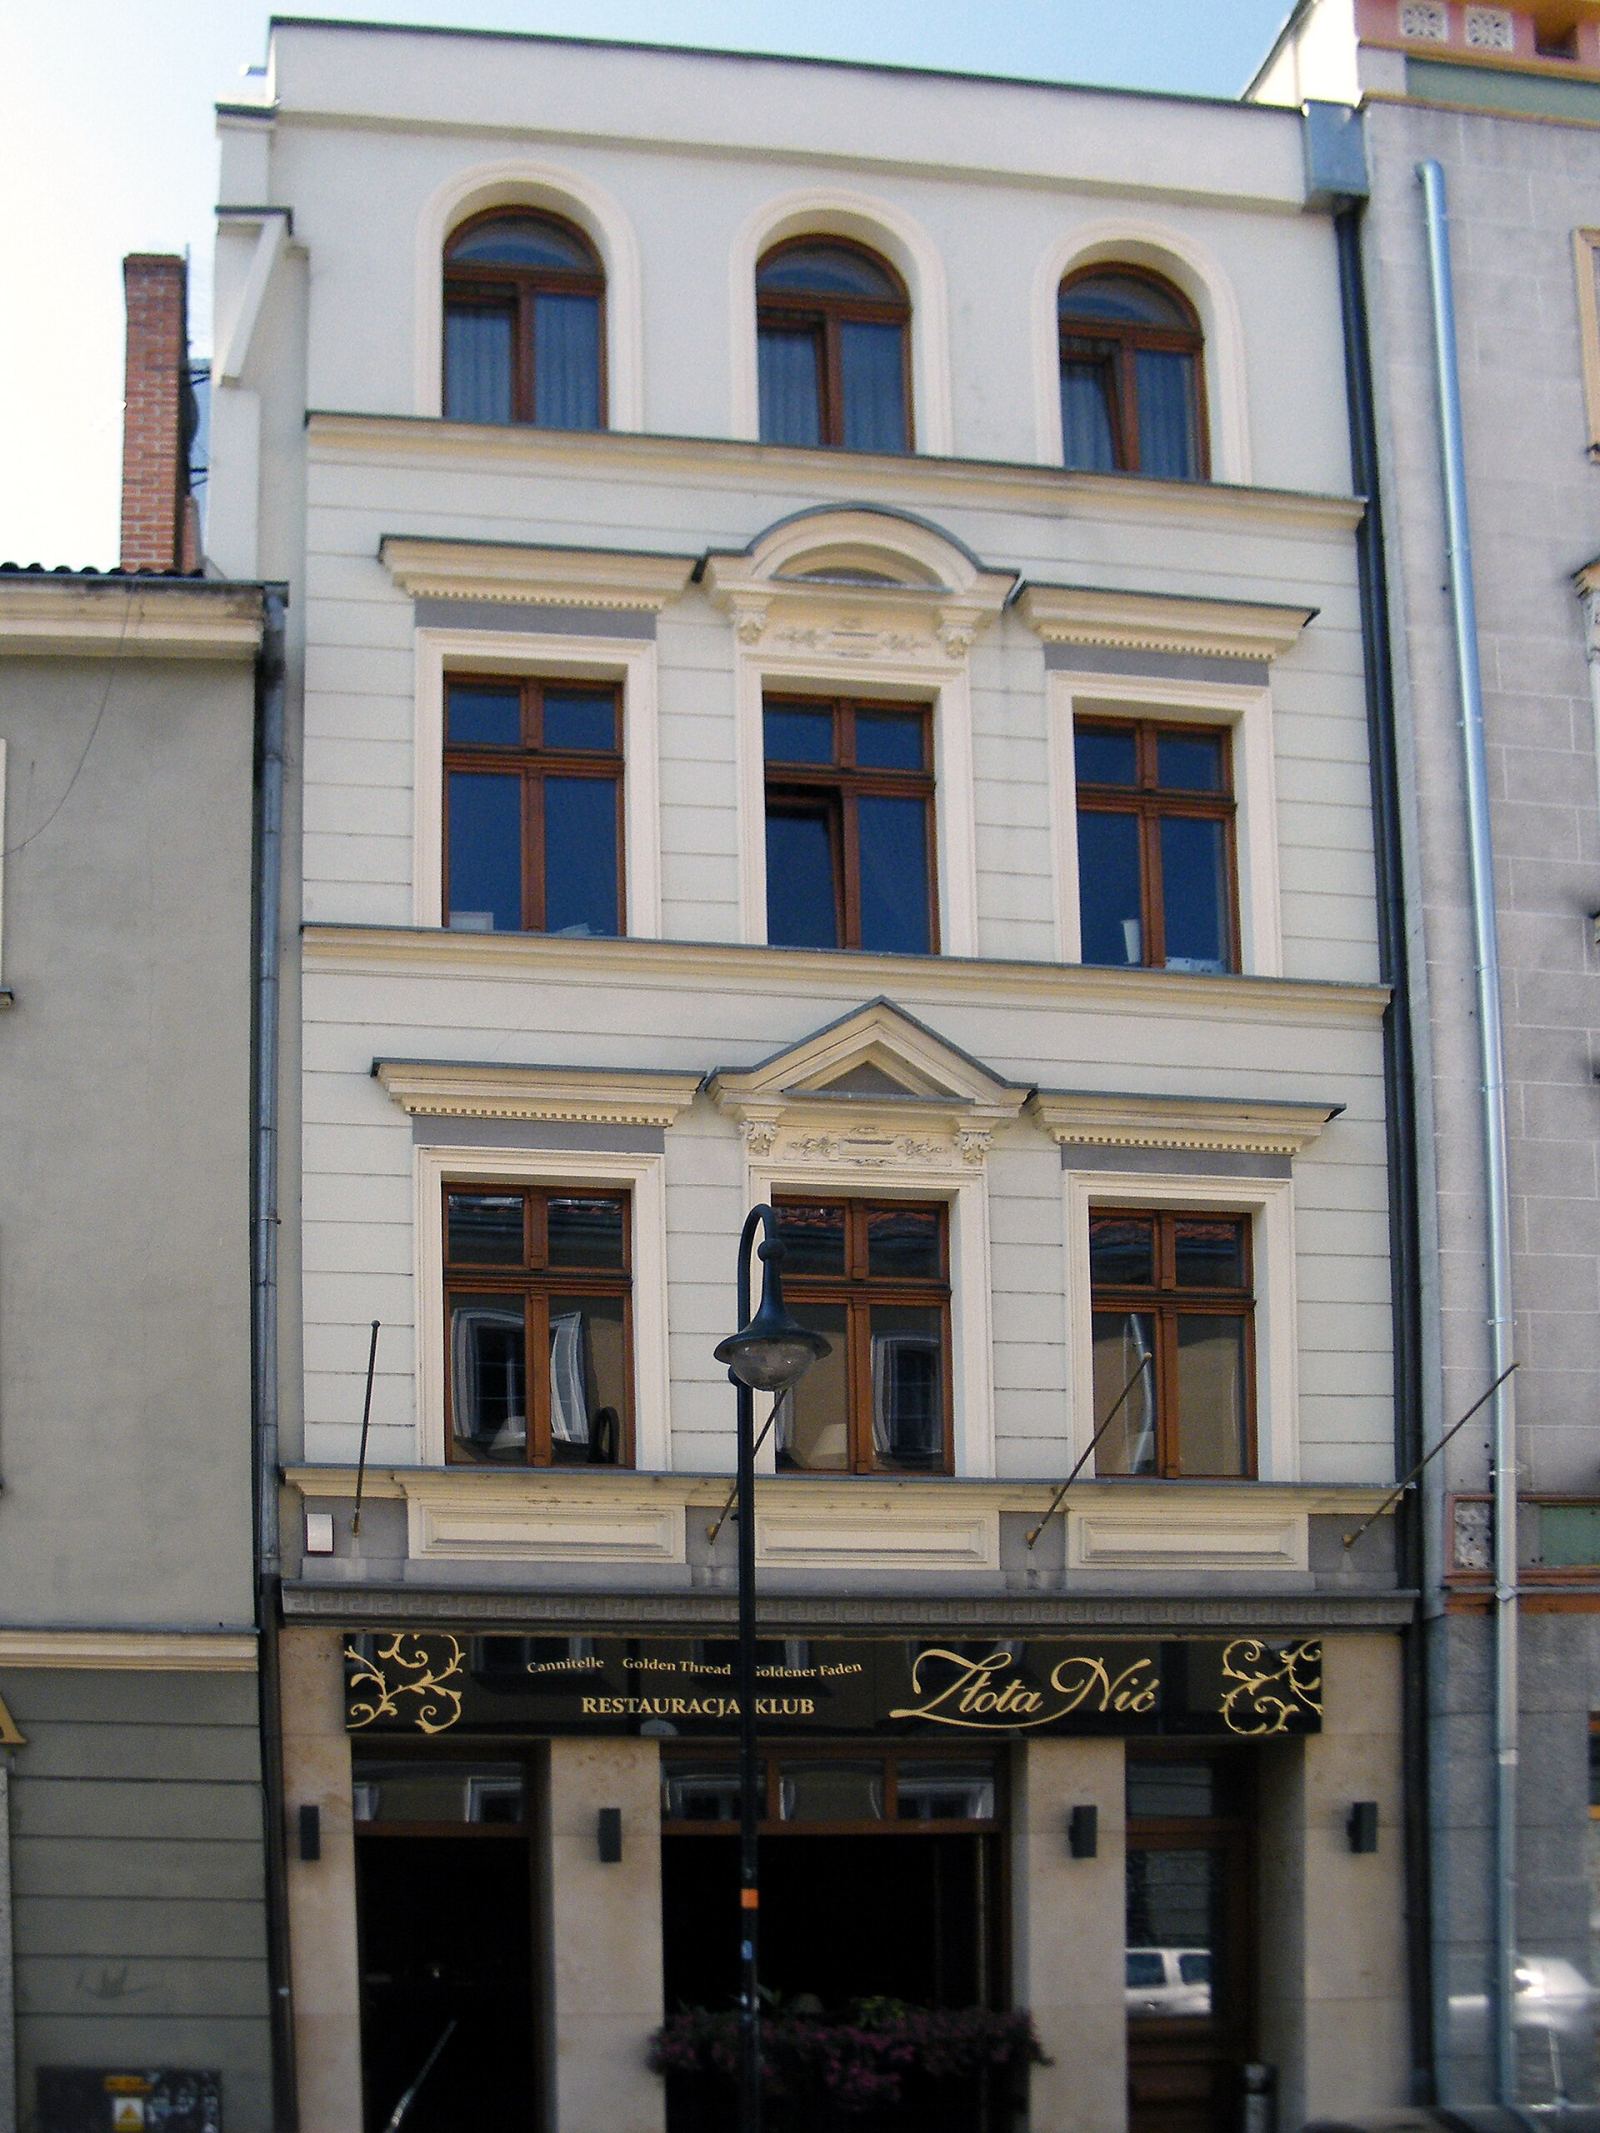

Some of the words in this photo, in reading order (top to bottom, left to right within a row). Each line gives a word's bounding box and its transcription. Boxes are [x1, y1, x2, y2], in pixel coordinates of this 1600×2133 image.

[526, 1656, 605, 1674] Cannitelle
[622, 1657, 677, 1671] Golden
[679, 1660, 732, 1675] Thread
[819, 1663, 863, 1676] Faden
[1050, 1657, 1161, 1713] Nić
[581, 1697, 741, 1718] RESTAURACJA
[755, 1698, 815, 1715] KLUB
